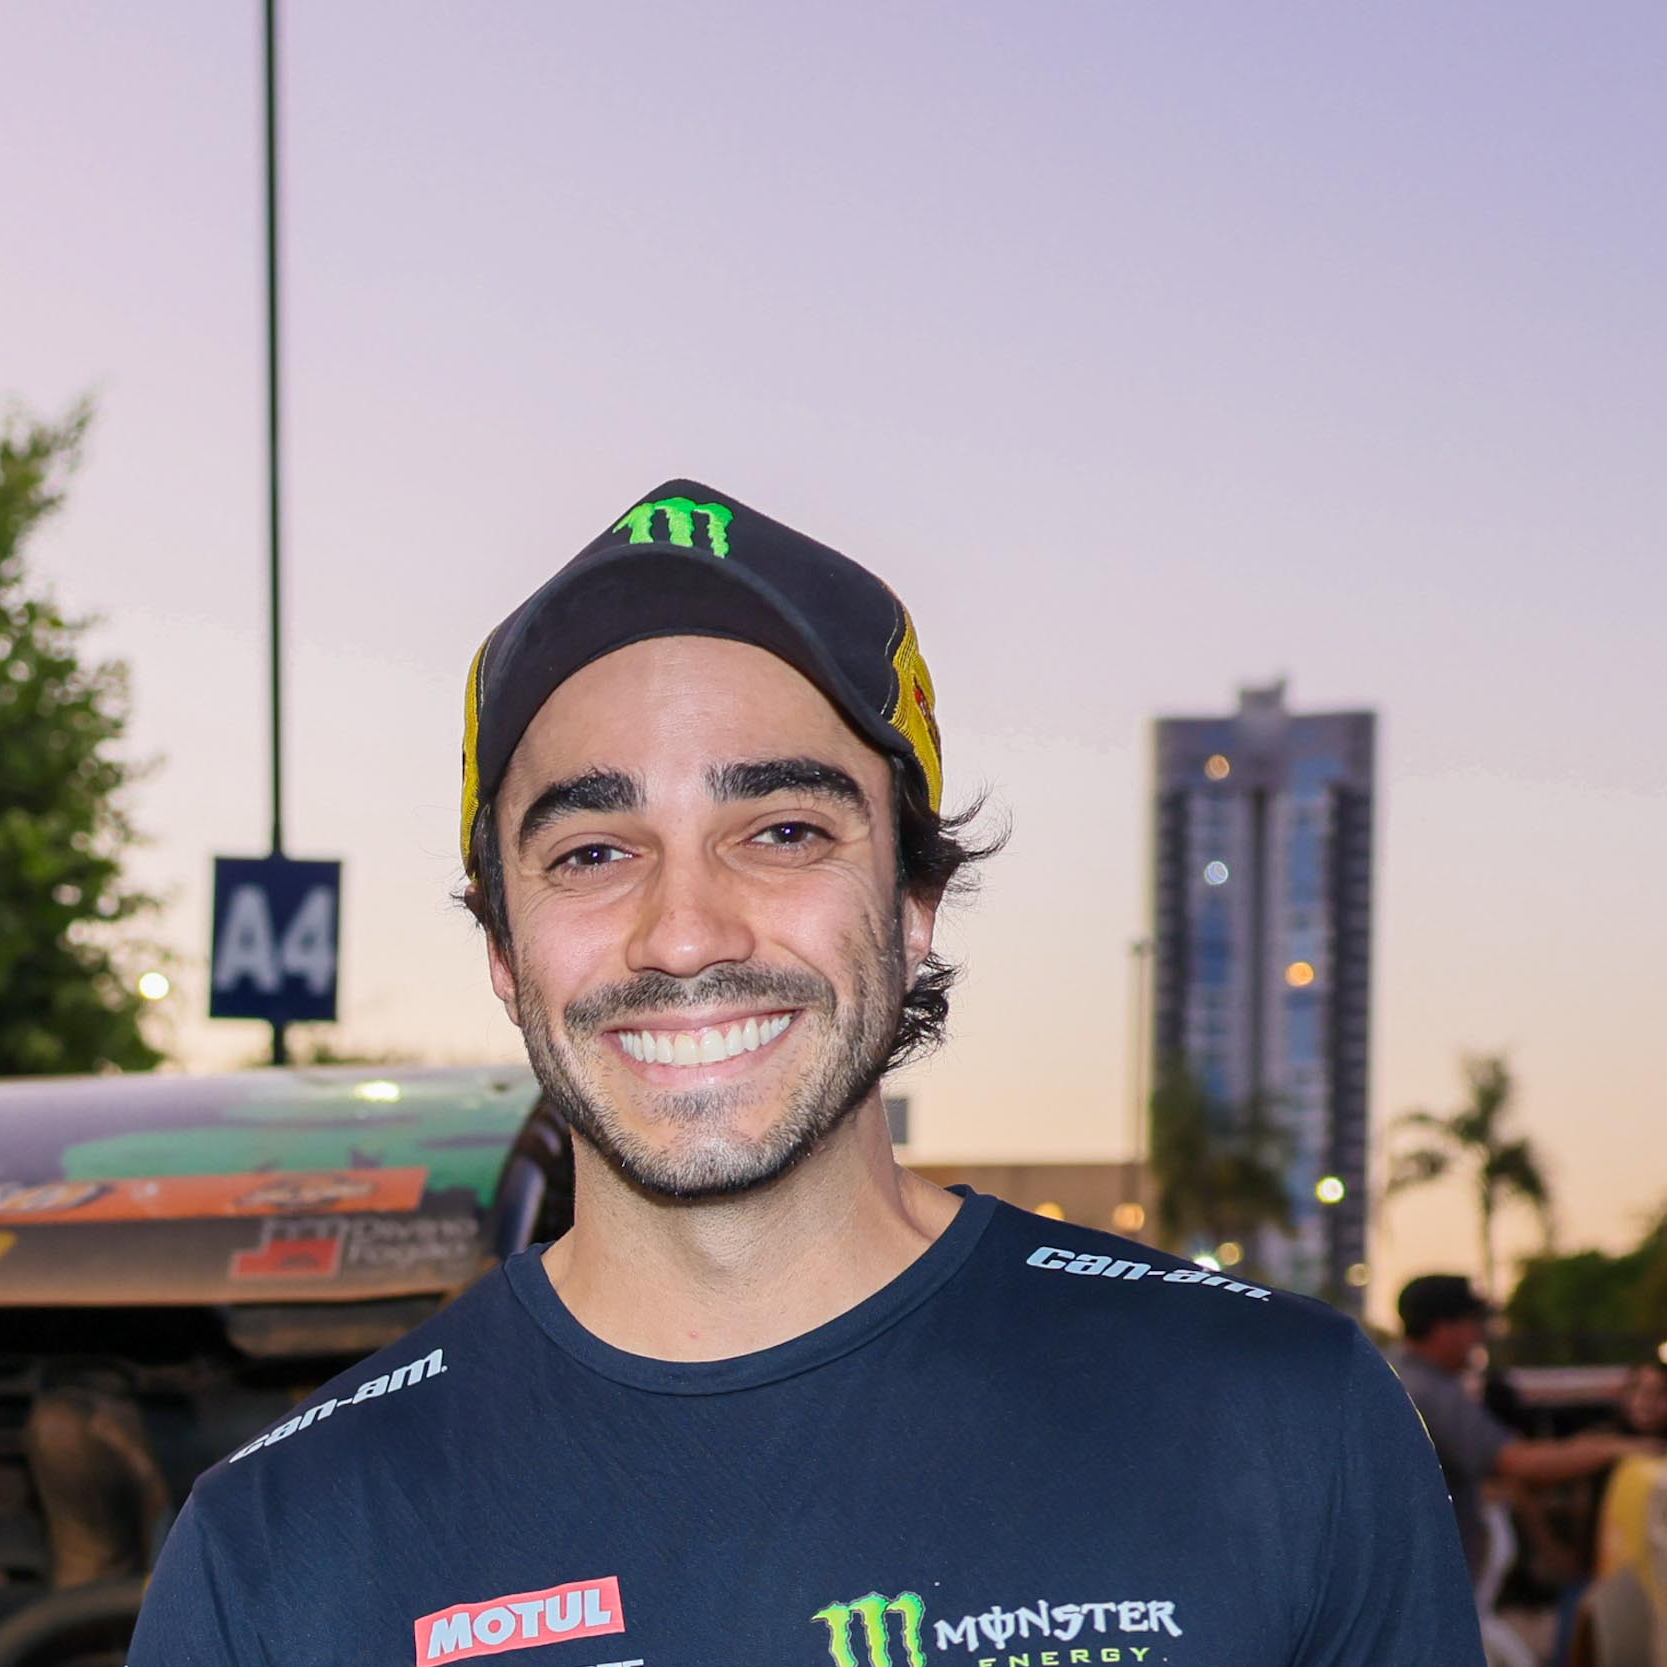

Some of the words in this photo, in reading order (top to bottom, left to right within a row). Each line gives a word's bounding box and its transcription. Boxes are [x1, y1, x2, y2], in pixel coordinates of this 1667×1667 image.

[217, 883, 335, 995] A4
[1026, 1246, 1271, 1301] can-am
[229, 1348, 448, 1463] can-am
[427, 1588, 611, 1660] MOTUL
